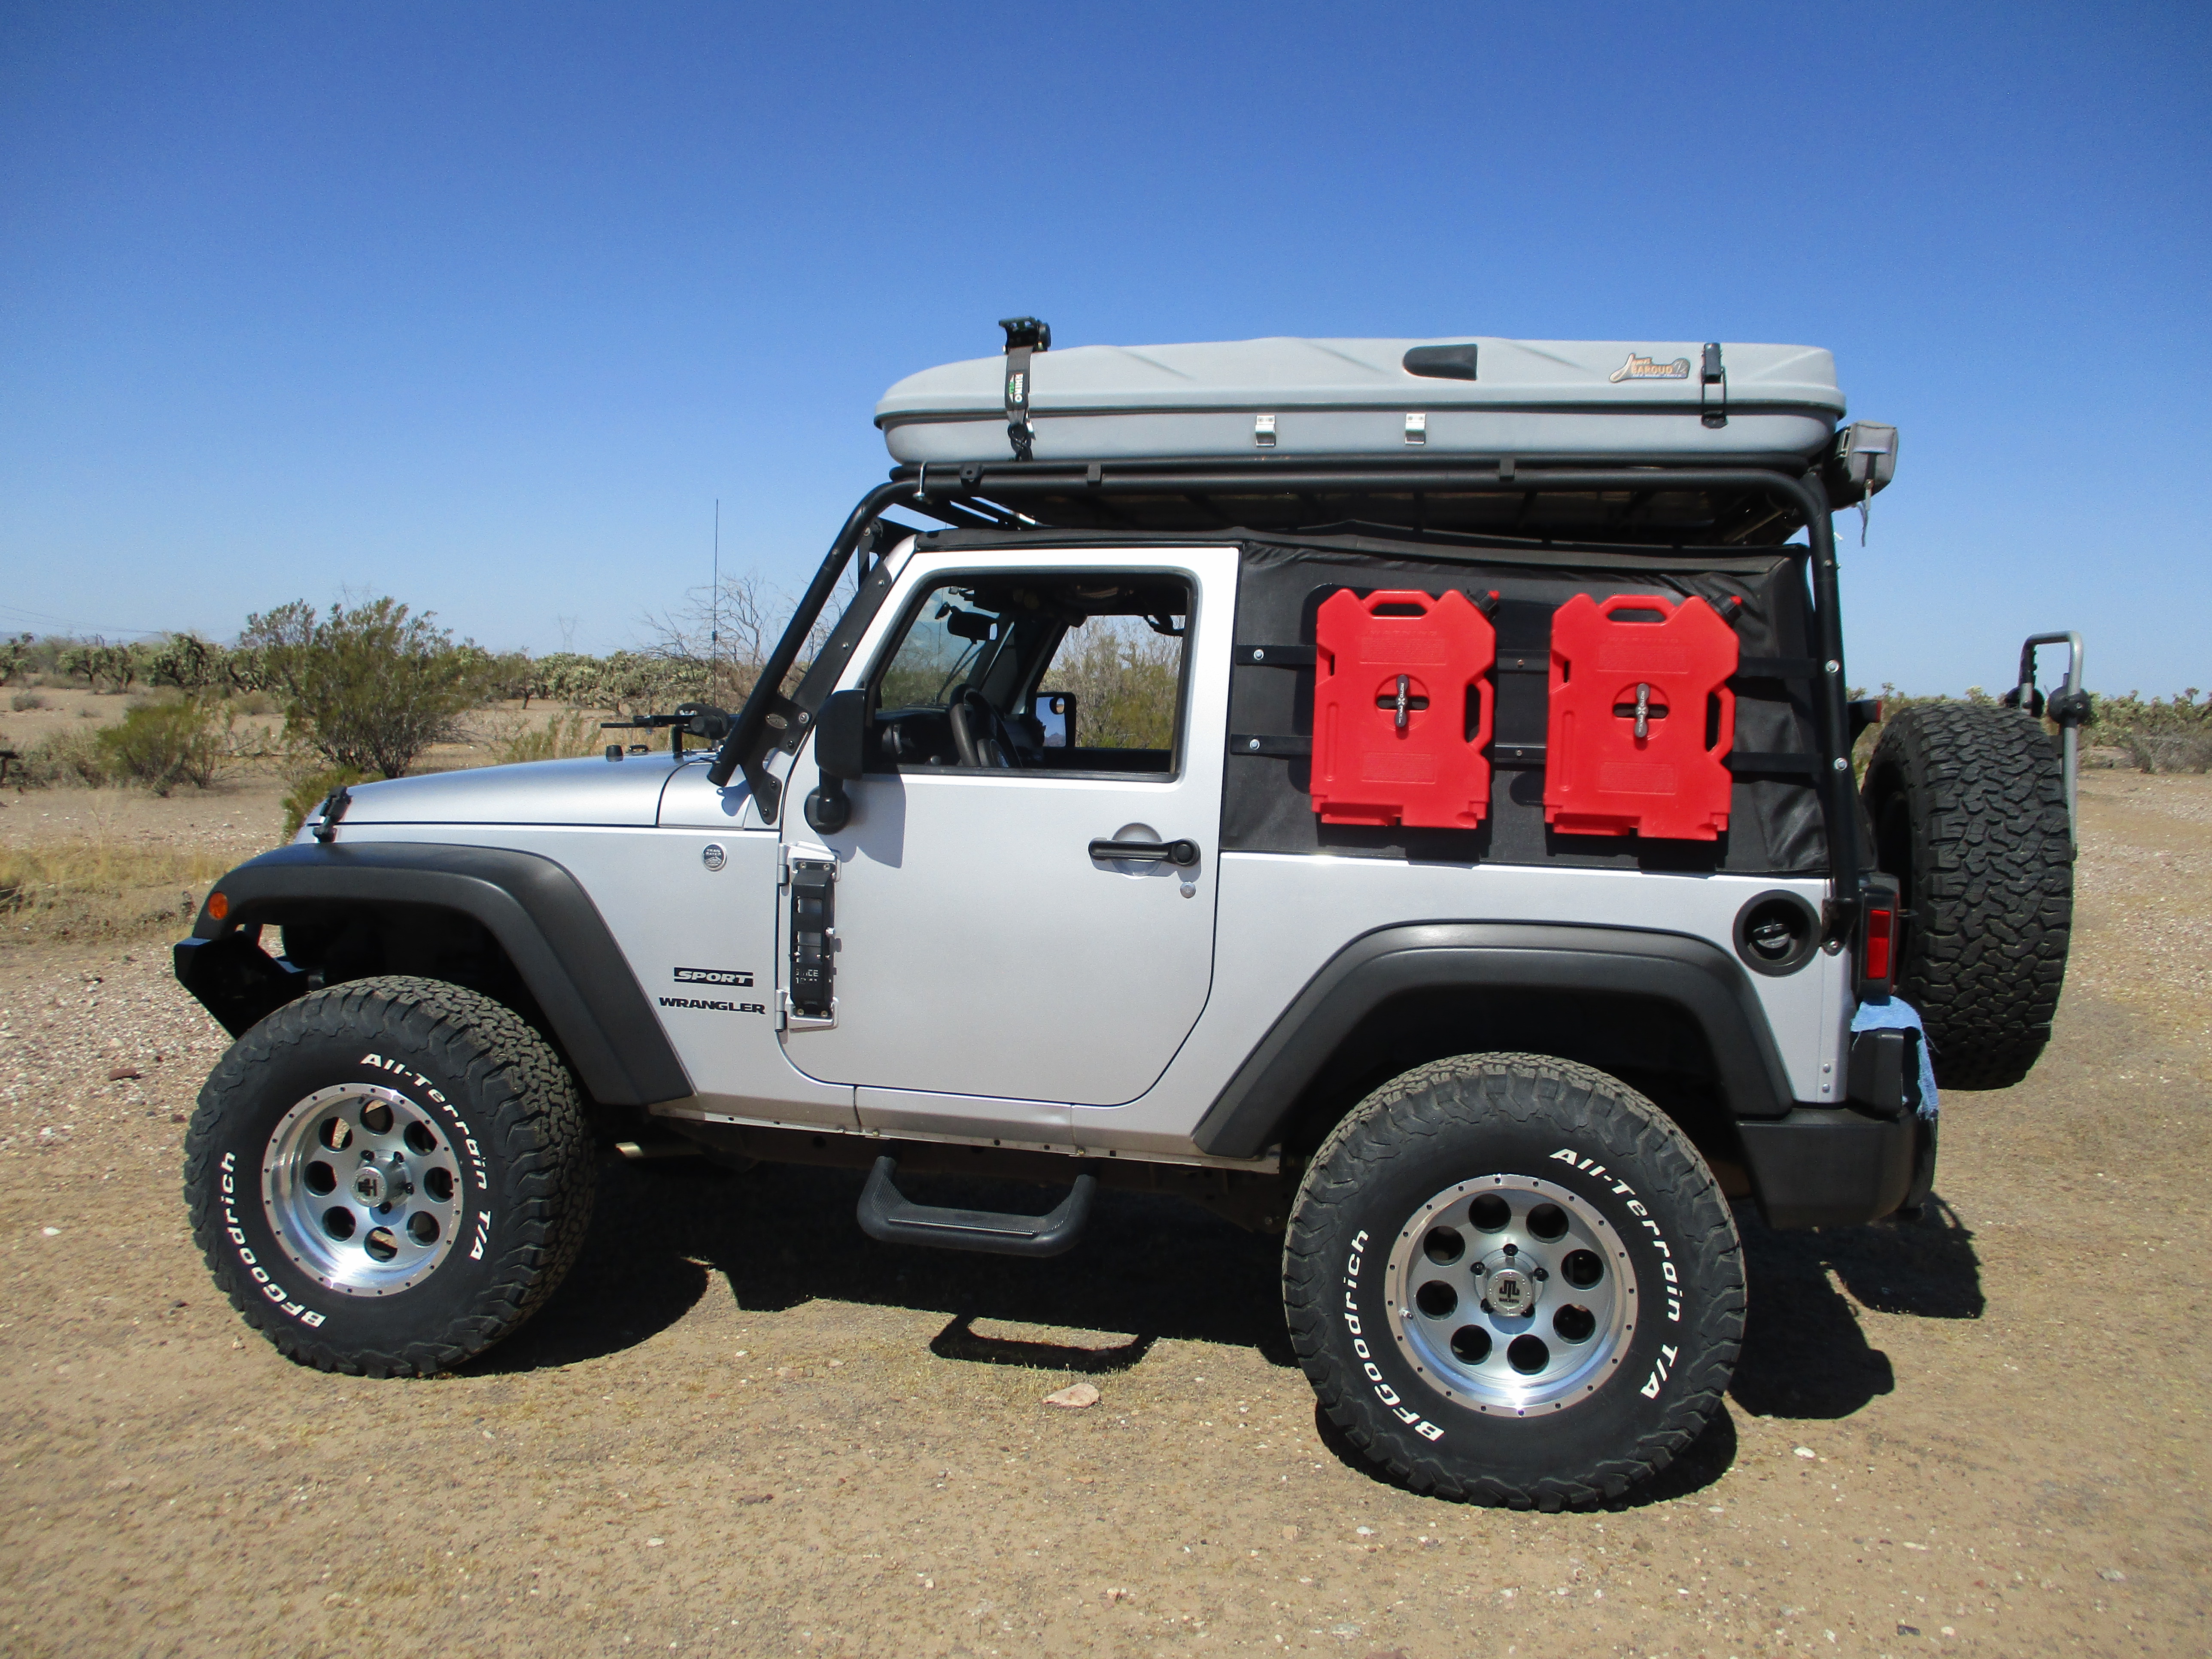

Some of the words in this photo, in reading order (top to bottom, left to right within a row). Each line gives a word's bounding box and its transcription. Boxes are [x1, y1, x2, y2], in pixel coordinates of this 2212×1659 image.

[1015, 373, 1023, 402] RHINO
[659, 997, 766, 1015] WRANGLER
[674, 970, 754, 984] SPORT
[219, 1151, 327, 1328] BFGoodrich
[361, 1052, 488, 1191] All-Terrain
[470, 1210, 492, 1261] T/A
[1343, 1230, 1445, 1442] BFGoodrich
[1549, 1148, 1683, 1322] All-Terrain
[1640, 1343, 1679, 1400] T/A
